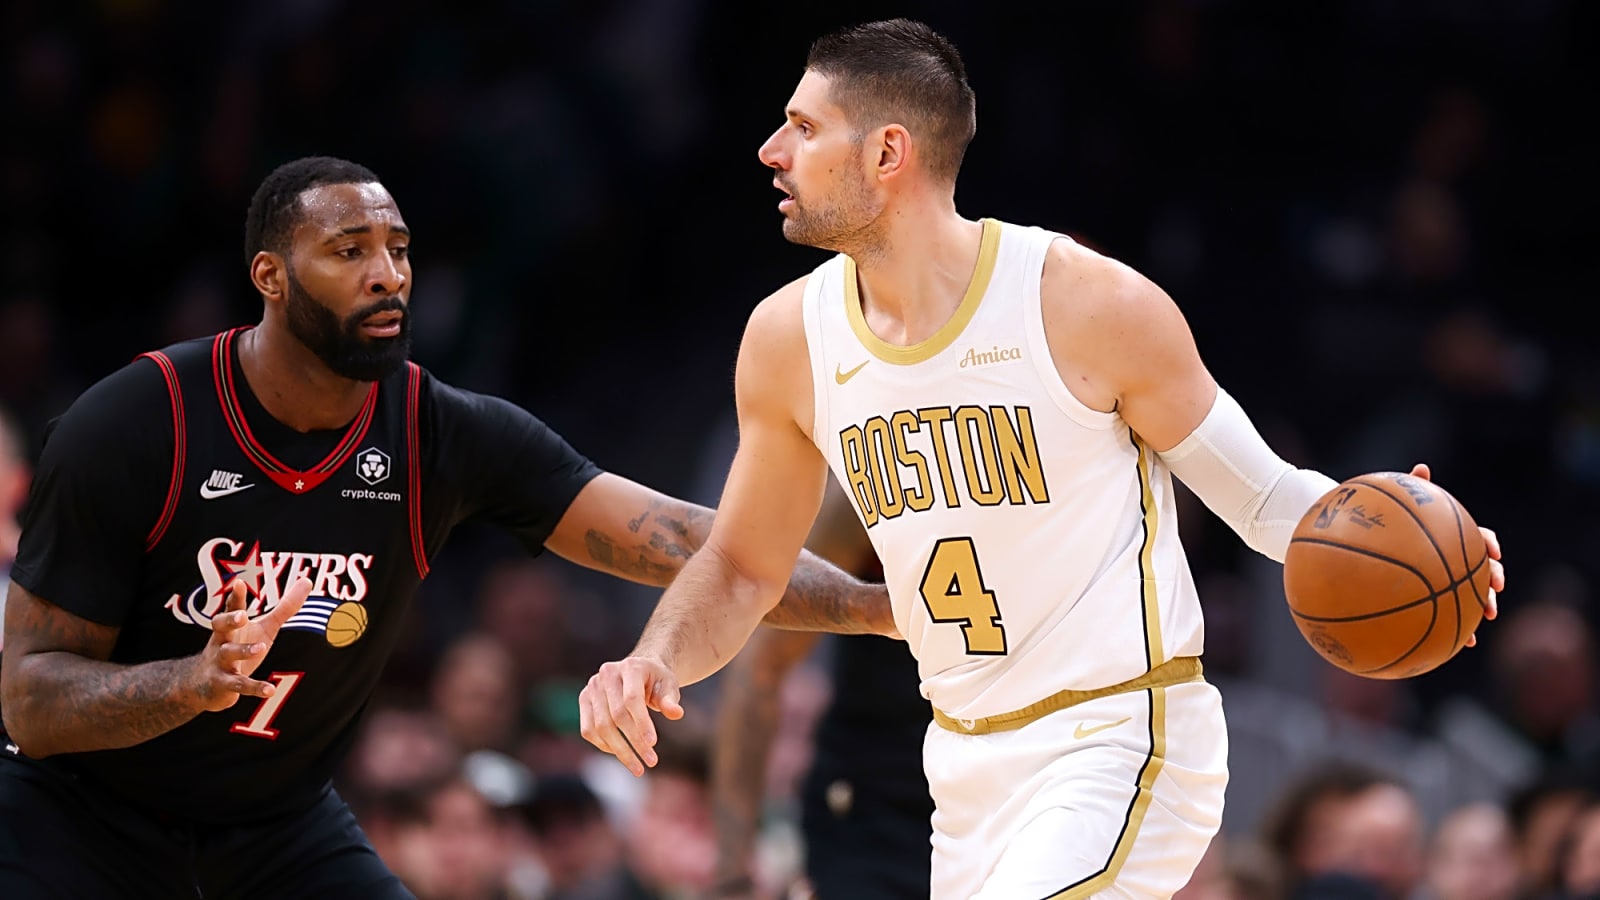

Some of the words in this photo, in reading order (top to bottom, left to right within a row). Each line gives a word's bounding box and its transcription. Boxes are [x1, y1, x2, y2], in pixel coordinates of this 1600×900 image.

[959, 346, 1022, 369] Amica
[207, 469, 244, 490] NIKE
[839, 405, 1051, 529] BOSTON
[341, 489, 401, 501] crypto.com
[918, 536, 1008, 656] 4
[229, 671, 306, 741] 1
